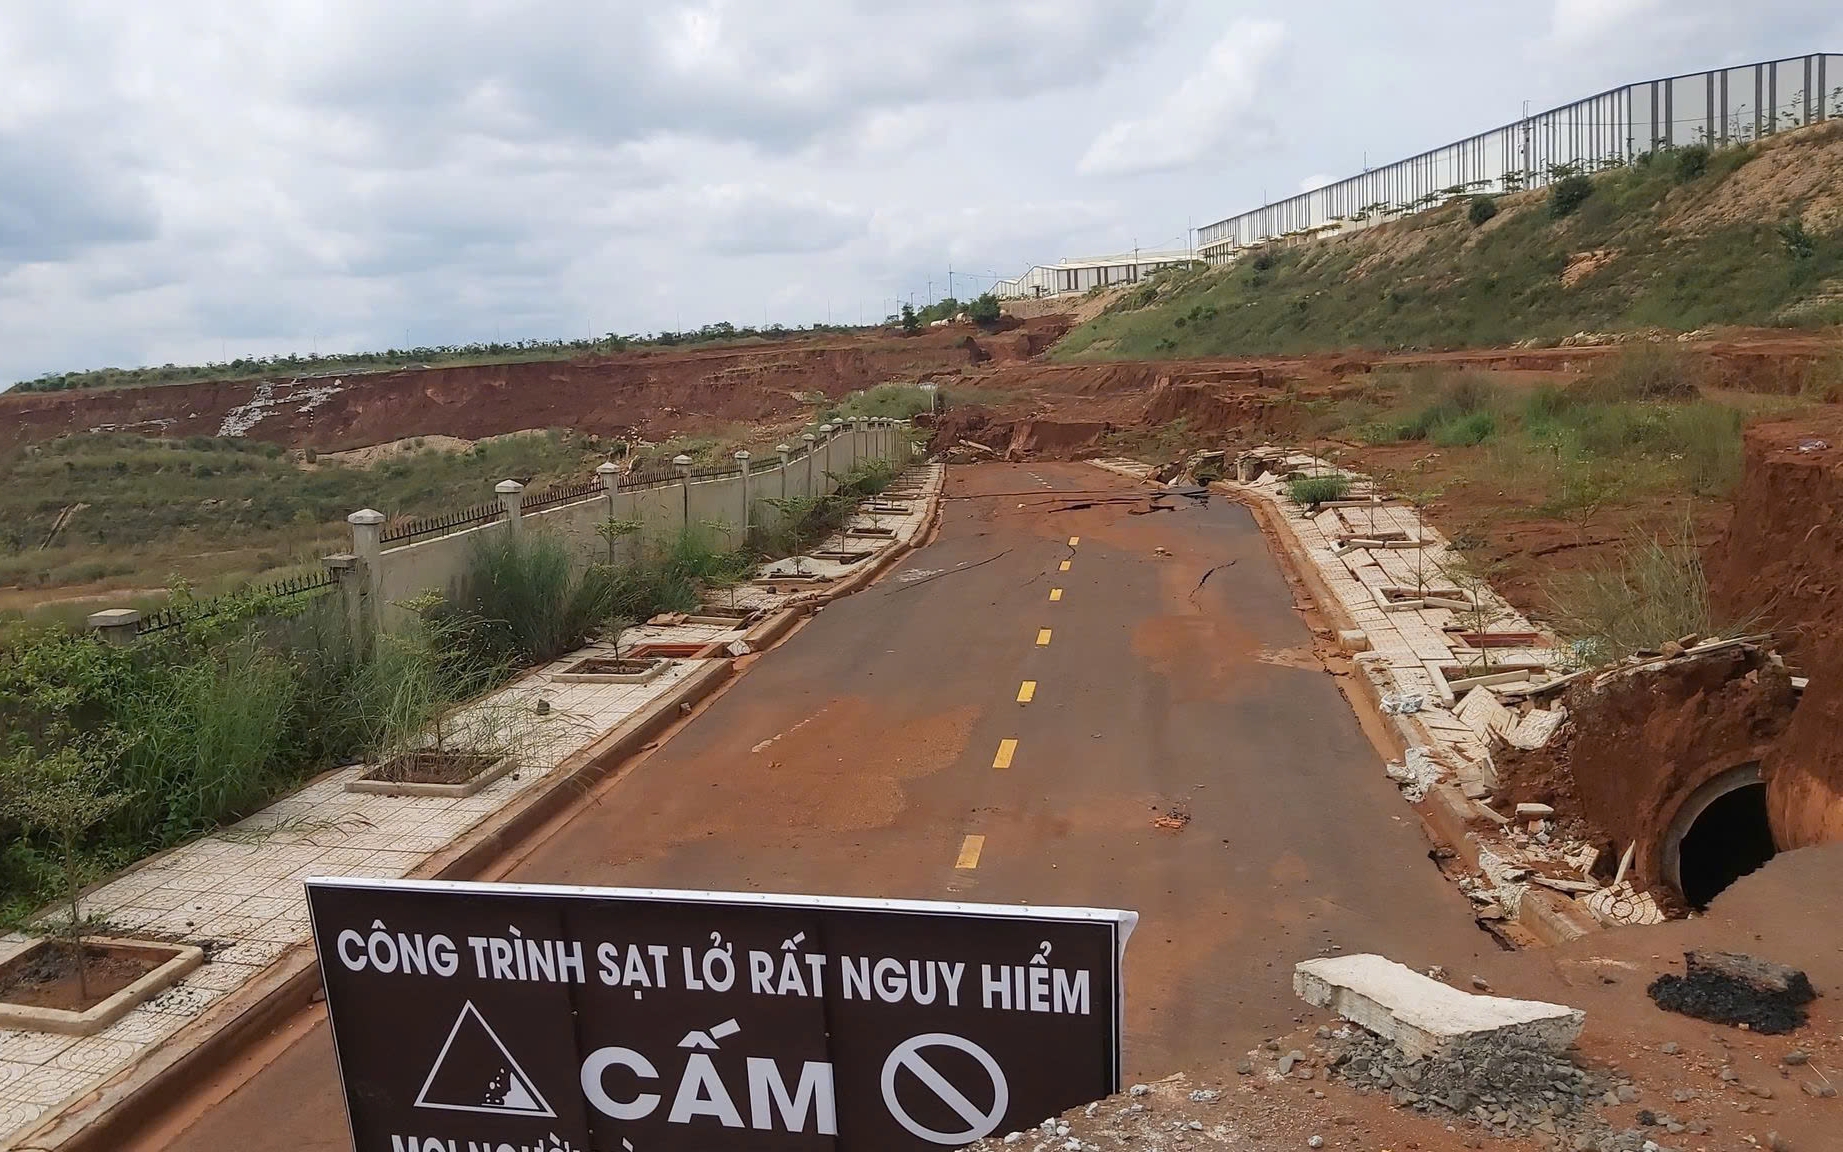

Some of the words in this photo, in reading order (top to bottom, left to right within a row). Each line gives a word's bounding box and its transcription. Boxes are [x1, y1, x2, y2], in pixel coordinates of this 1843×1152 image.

[337, 919, 459, 977] CÔNG
[467, 924, 586, 984] TRÌNH
[597, 942, 669, 1000] SẠT
[682, 931, 737, 992] LỞ
[749, 931, 828, 998] RẤT
[841, 955, 966, 1007] NGUY
[981, 940, 1091, 1015] HIỂM
[580, 1018, 838, 1135] CẤM
